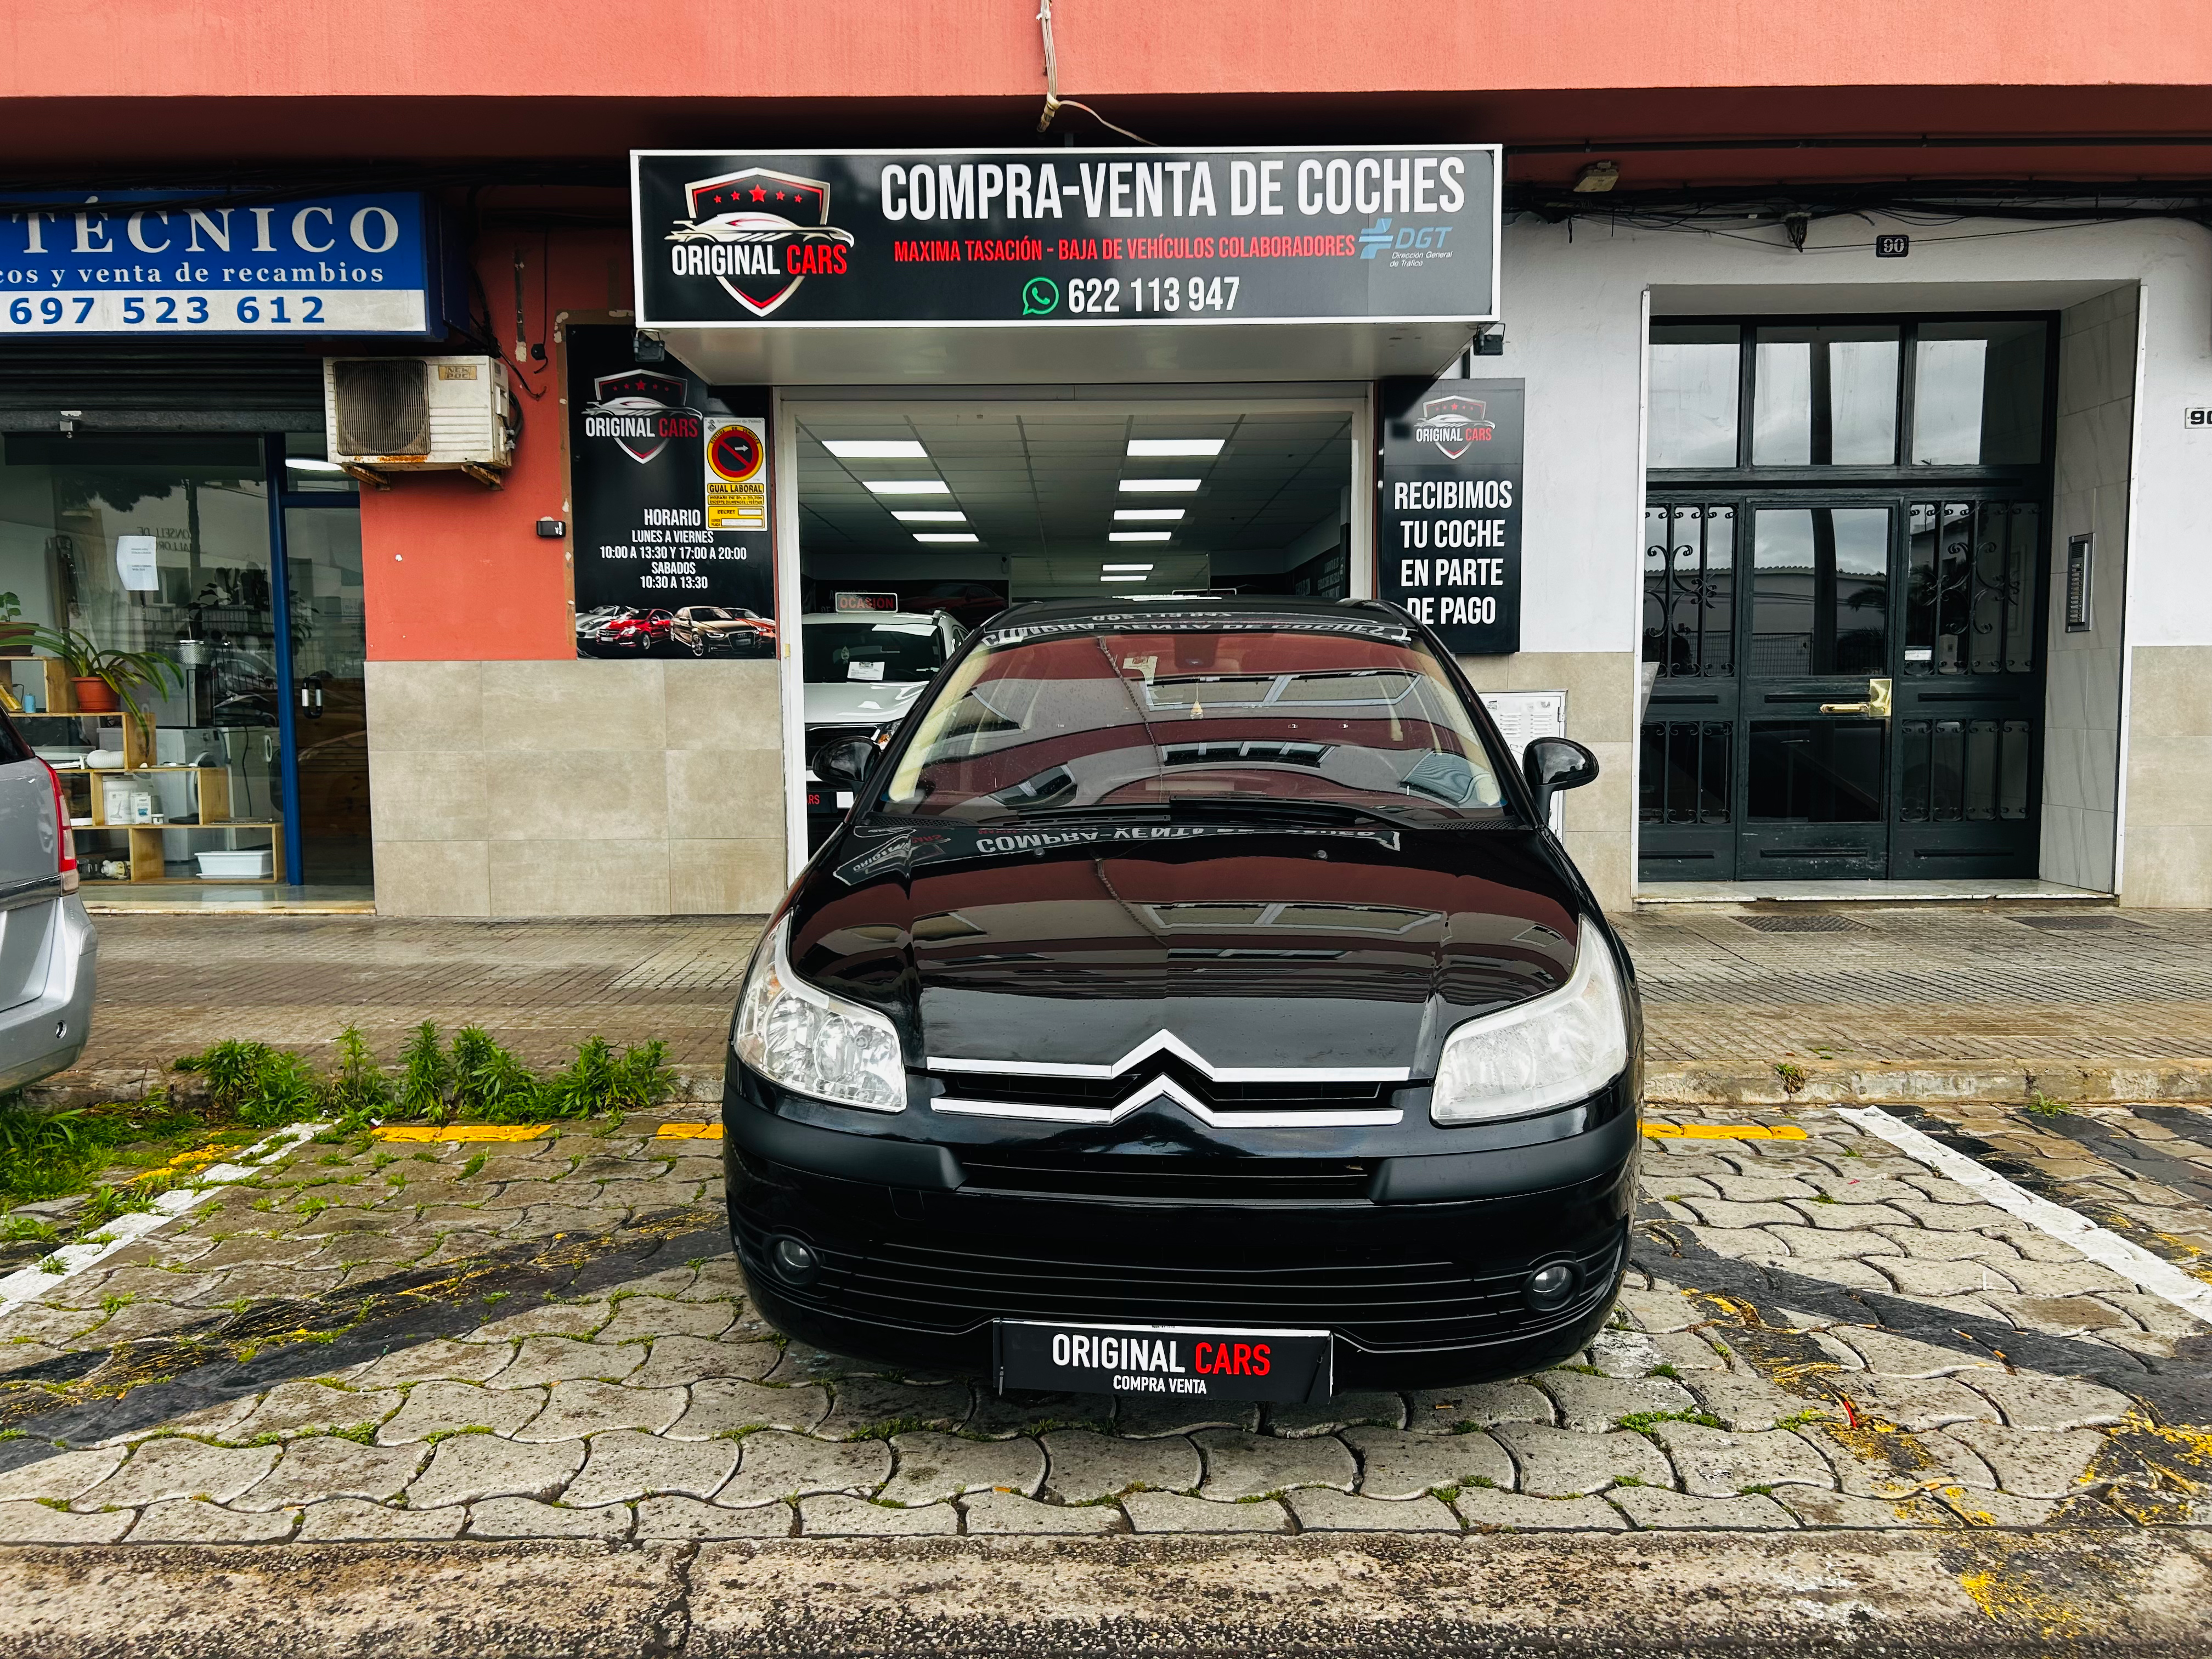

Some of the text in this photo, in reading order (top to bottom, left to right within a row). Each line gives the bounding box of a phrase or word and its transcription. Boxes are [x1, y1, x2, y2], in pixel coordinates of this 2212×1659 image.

[881, 156, 1465, 221] COMPRA-VENTA DE COCHES
[11, 195, 399, 253] TÉCNICO
[894, 240, 961, 262] MAXIMA
[964, 235, 1042, 262] TASACIÓN
[1058, 239, 1098, 261] BAJA
[1102, 239, 1122, 260] DE
[1126, 234, 1215, 259] VEHÍCULOS
[1218, 234, 1356, 258] COLABORADORES
[1395, 226, 1453, 249] DGT
[1883, 238, 1905, 253] 90
[671, 244, 848, 276] ORIGINAL CARS
[1392, 250, 1453, 259] Dirección General
[1401, 259, 1424, 267] Tráfico
[52, 267, 65, 287] y
[77, 264, 161, 282] venta
[176, 261, 208, 282] de
[222, 261, 384, 282] recambios
[1068, 275, 1240, 313] 622 113 947
[9, 296, 325, 324] 697 523 612
[585, 417, 698, 438] ORIGINAL CARS
[1415, 427, 1492, 442] ORIGINAL CARS
[709, 484, 762, 493] GUAL LABORAL
[1394, 480, 1513, 510] RECIBIMOS
[644, 509, 701, 526] HORARIO
[631, 531, 714, 544] LUNES A VIERNES
[1400, 520, 1505, 549] TU COCHE
[600, 546, 747, 560] 10:00 A 13:30 Y 17:00 A 20:00
[651, 561, 696, 574] SABADOS
[1401, 558, 1504, 587] EN PARTE
[640, 576, 708, 589] 10:30 A 13:30
[839, 595, 894, 609] OCASIÓN
[1407, 596, 1496, 624] DE PAGO
[1052, 1333, 1271, 1376] ORIGINAL CARS
[1113, 1375, 1207, 1395] COMPRA VENTA
